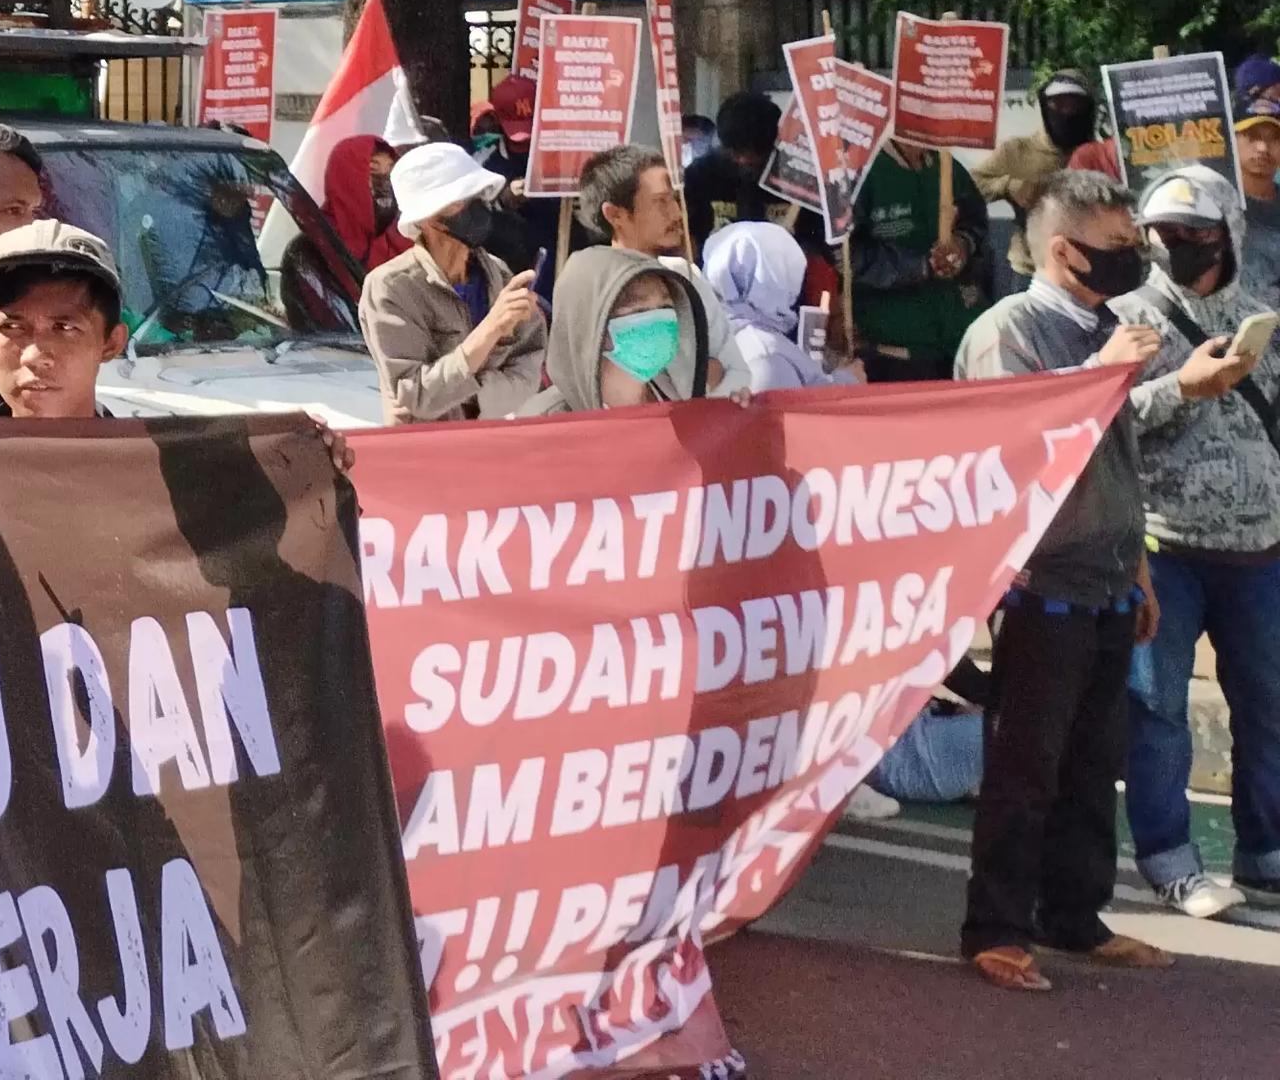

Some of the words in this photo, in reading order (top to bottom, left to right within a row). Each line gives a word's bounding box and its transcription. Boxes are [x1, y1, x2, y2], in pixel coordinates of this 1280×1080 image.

[358, 490, 678, 609] RAKYAT
[678, 444, 1018, 566] INDONESIA
[39, 607, 281, 809] DAN
[404, 614, 683, 733] SUDAH
[693, 565, 953, 694] DEWASA
